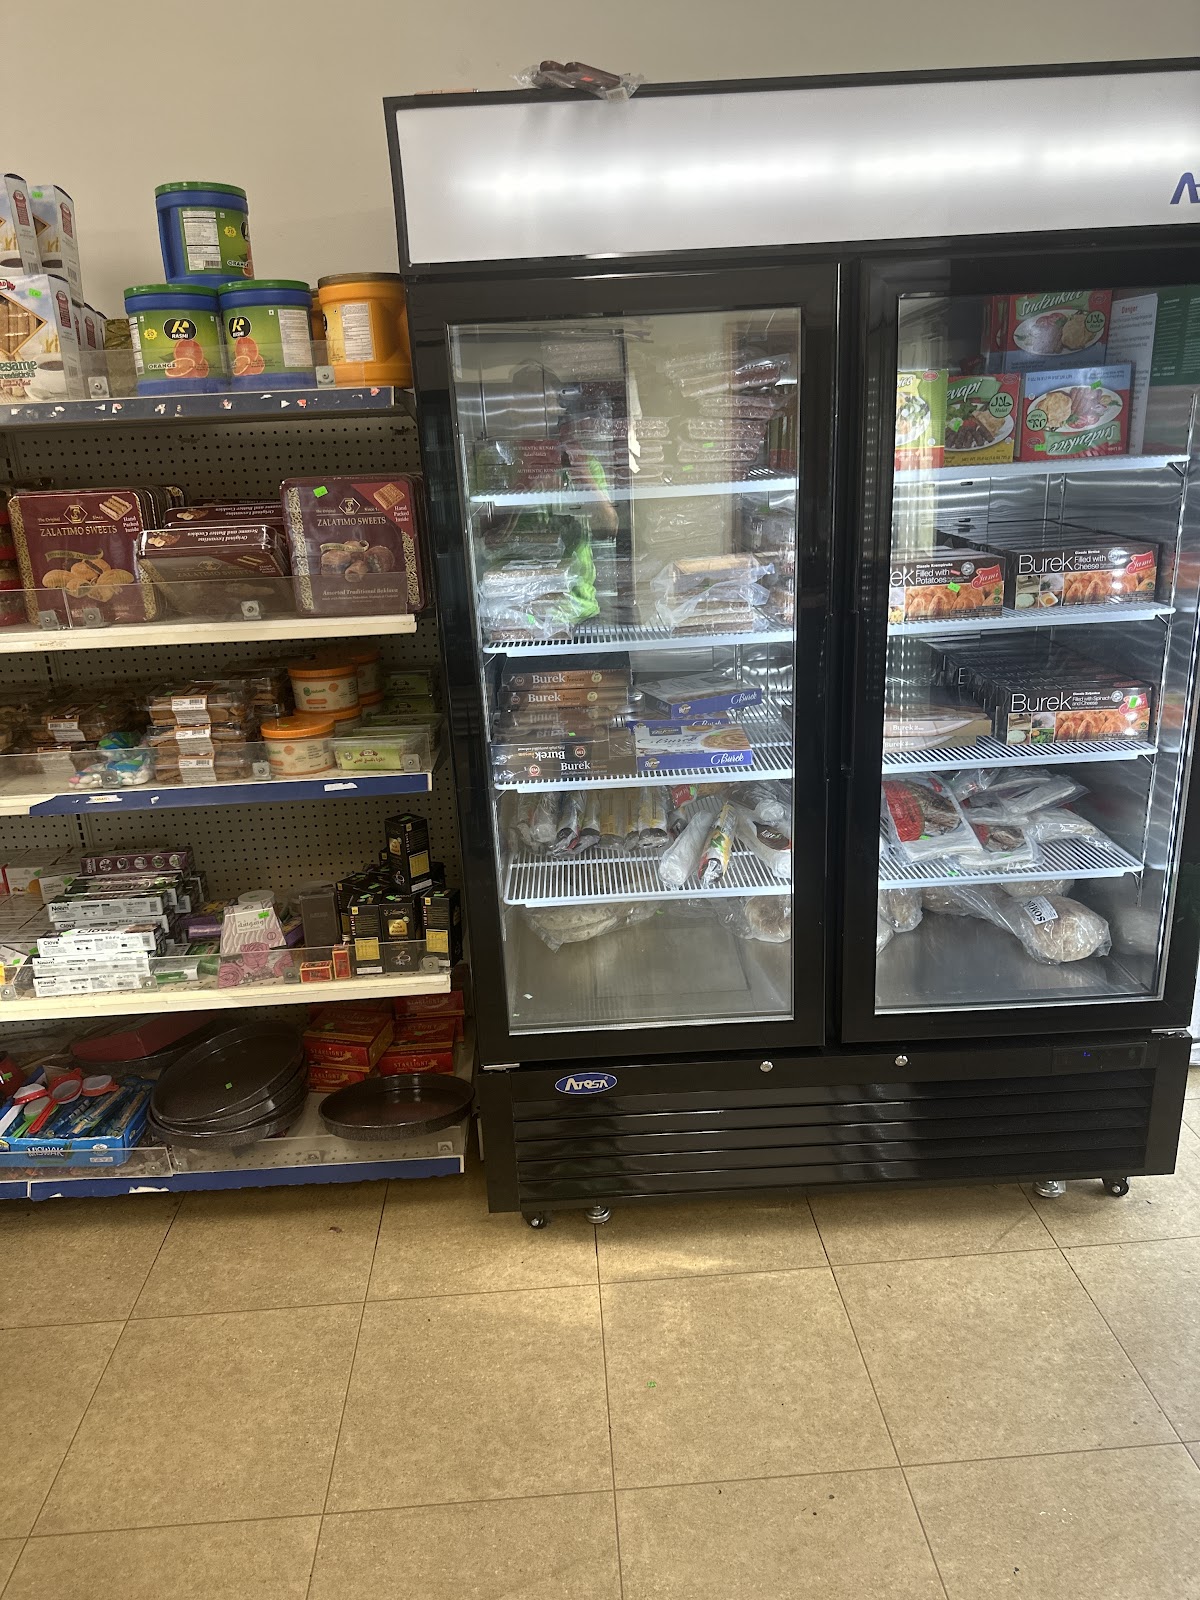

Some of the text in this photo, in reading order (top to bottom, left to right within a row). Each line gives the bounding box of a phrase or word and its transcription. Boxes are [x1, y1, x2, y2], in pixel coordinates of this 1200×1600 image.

[40, 525, 118, 537] ZALATIMO SWEETS
[1018, 552, 1073, 574] Burek
[1074, 555, 1091, 563] Filled
[916, 569, 933, 578] Filled
[532, 674, 566, 684] Burek
[528, 692, 561, 702] Burek
[1011, 692, 1073, 712] Burek
[535, 751, 565, 761] Burek
[711, 753, 744, 765] Burek
[561, 761, 591, 770] Burek
[311, 1049, 343, 1057] STARLIGHT
[394, 1059, 428, 1068] STARLIGHT
[27, 1146, 64, 1157] MISWAK
